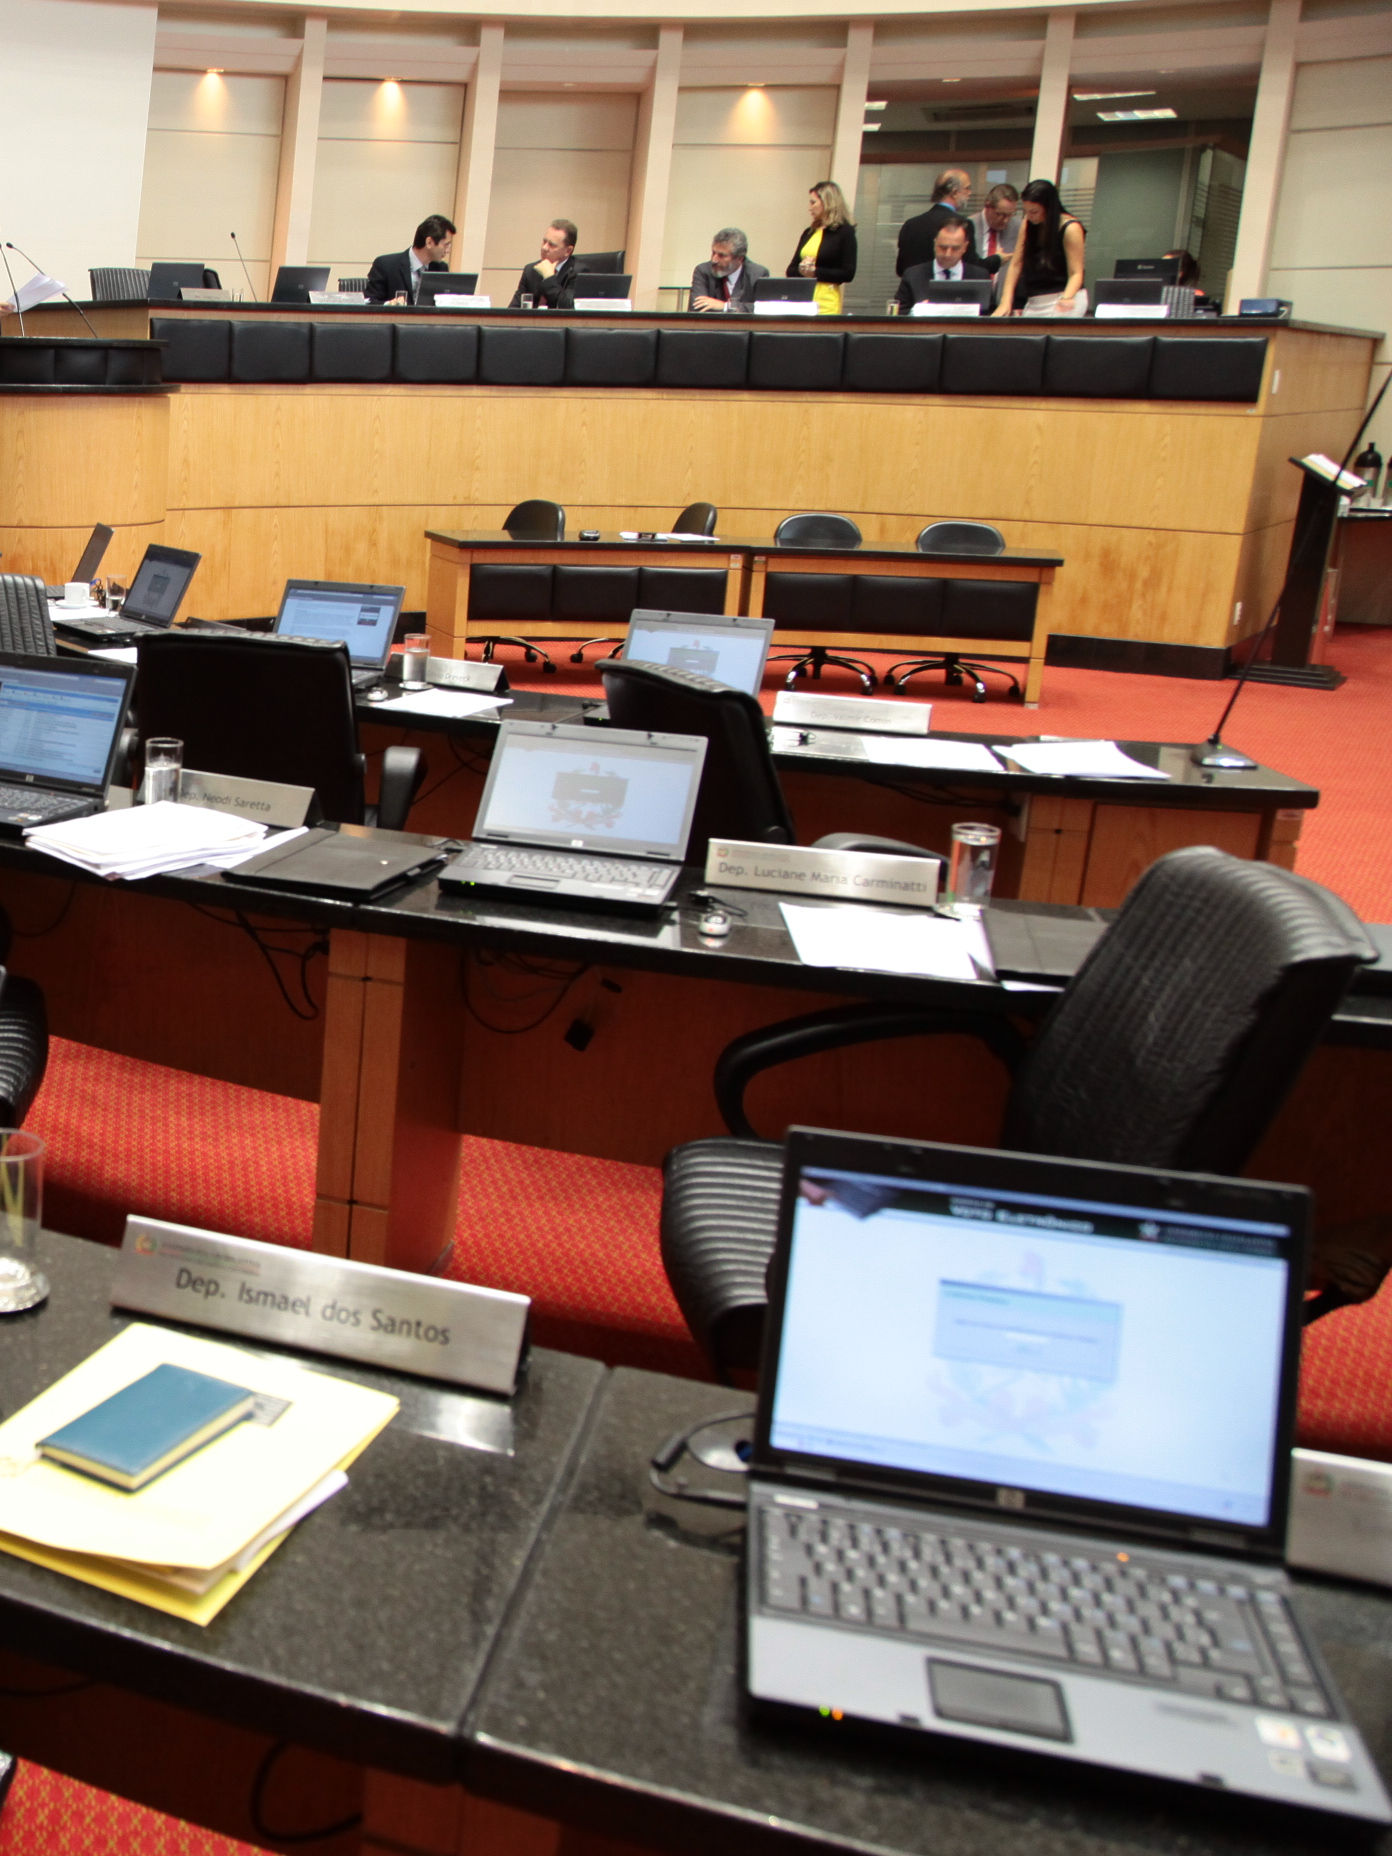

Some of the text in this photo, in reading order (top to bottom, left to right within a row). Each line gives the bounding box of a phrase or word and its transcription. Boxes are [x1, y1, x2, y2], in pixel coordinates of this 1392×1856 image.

[234, 797, 271, 812] Saretta
[718, 862, 927, 893] Dep. Luciane Maria Carminatti
[175, 1268, 450, 1346] Dep. Ismael dos Santos
